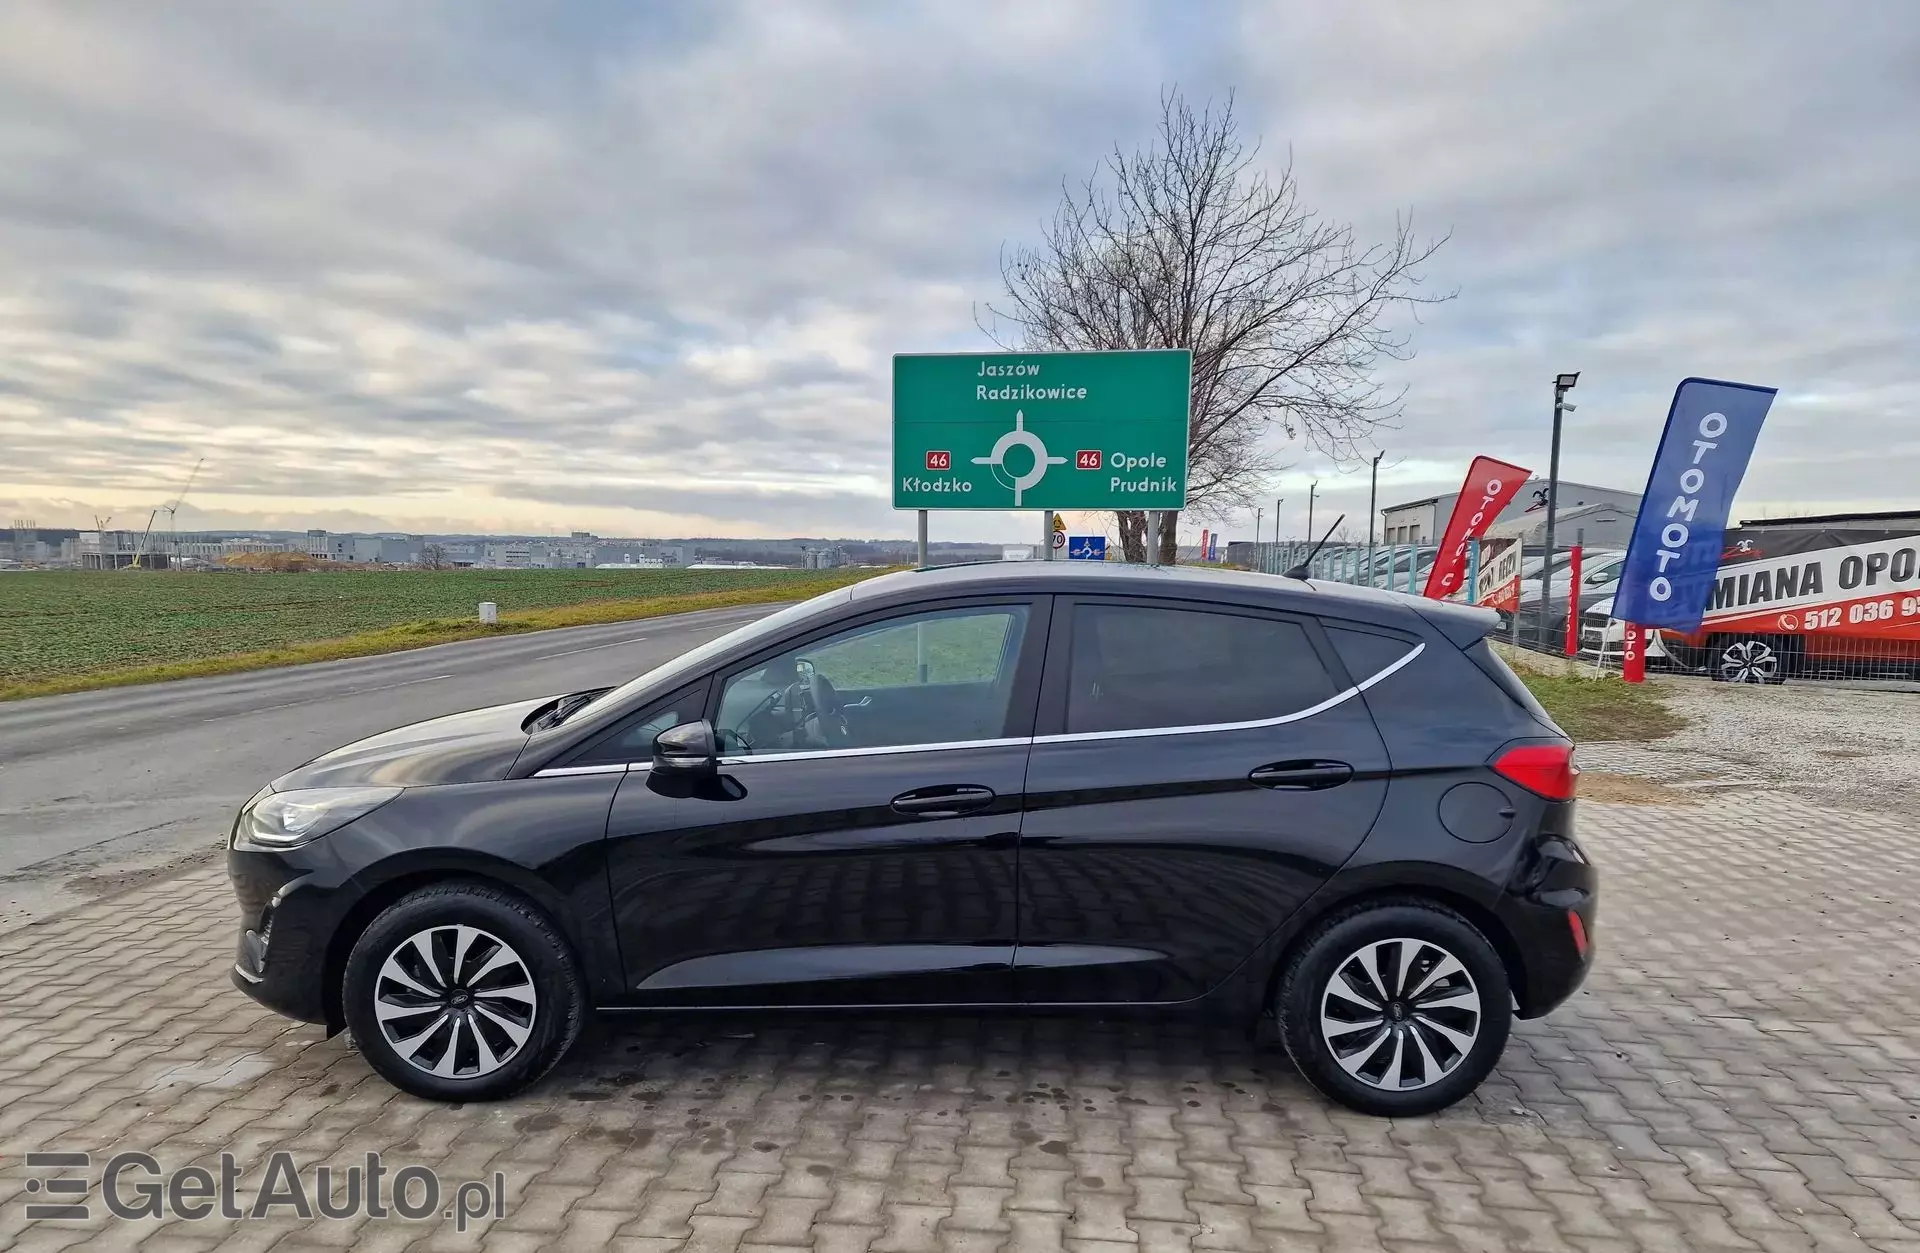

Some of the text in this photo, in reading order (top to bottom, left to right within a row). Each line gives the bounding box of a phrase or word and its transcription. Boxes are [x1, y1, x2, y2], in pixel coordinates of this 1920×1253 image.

[977, 361, 1040, 377] Jaszów
[977, 384, 1087, 400] Radzikowice
[930, 453, 947, 467] 46
[1079, 453, 1167, 472] 46 Opole
[902, 477, 972, 492] Kłodzko
[1110, 477, 1177, 493] Prudnik
[1650, 412, 1728, 602] OTOMOTO
[1839, 547, 1920, 589] OPO
[1804, 596, 1920, 630] 512 036 9
